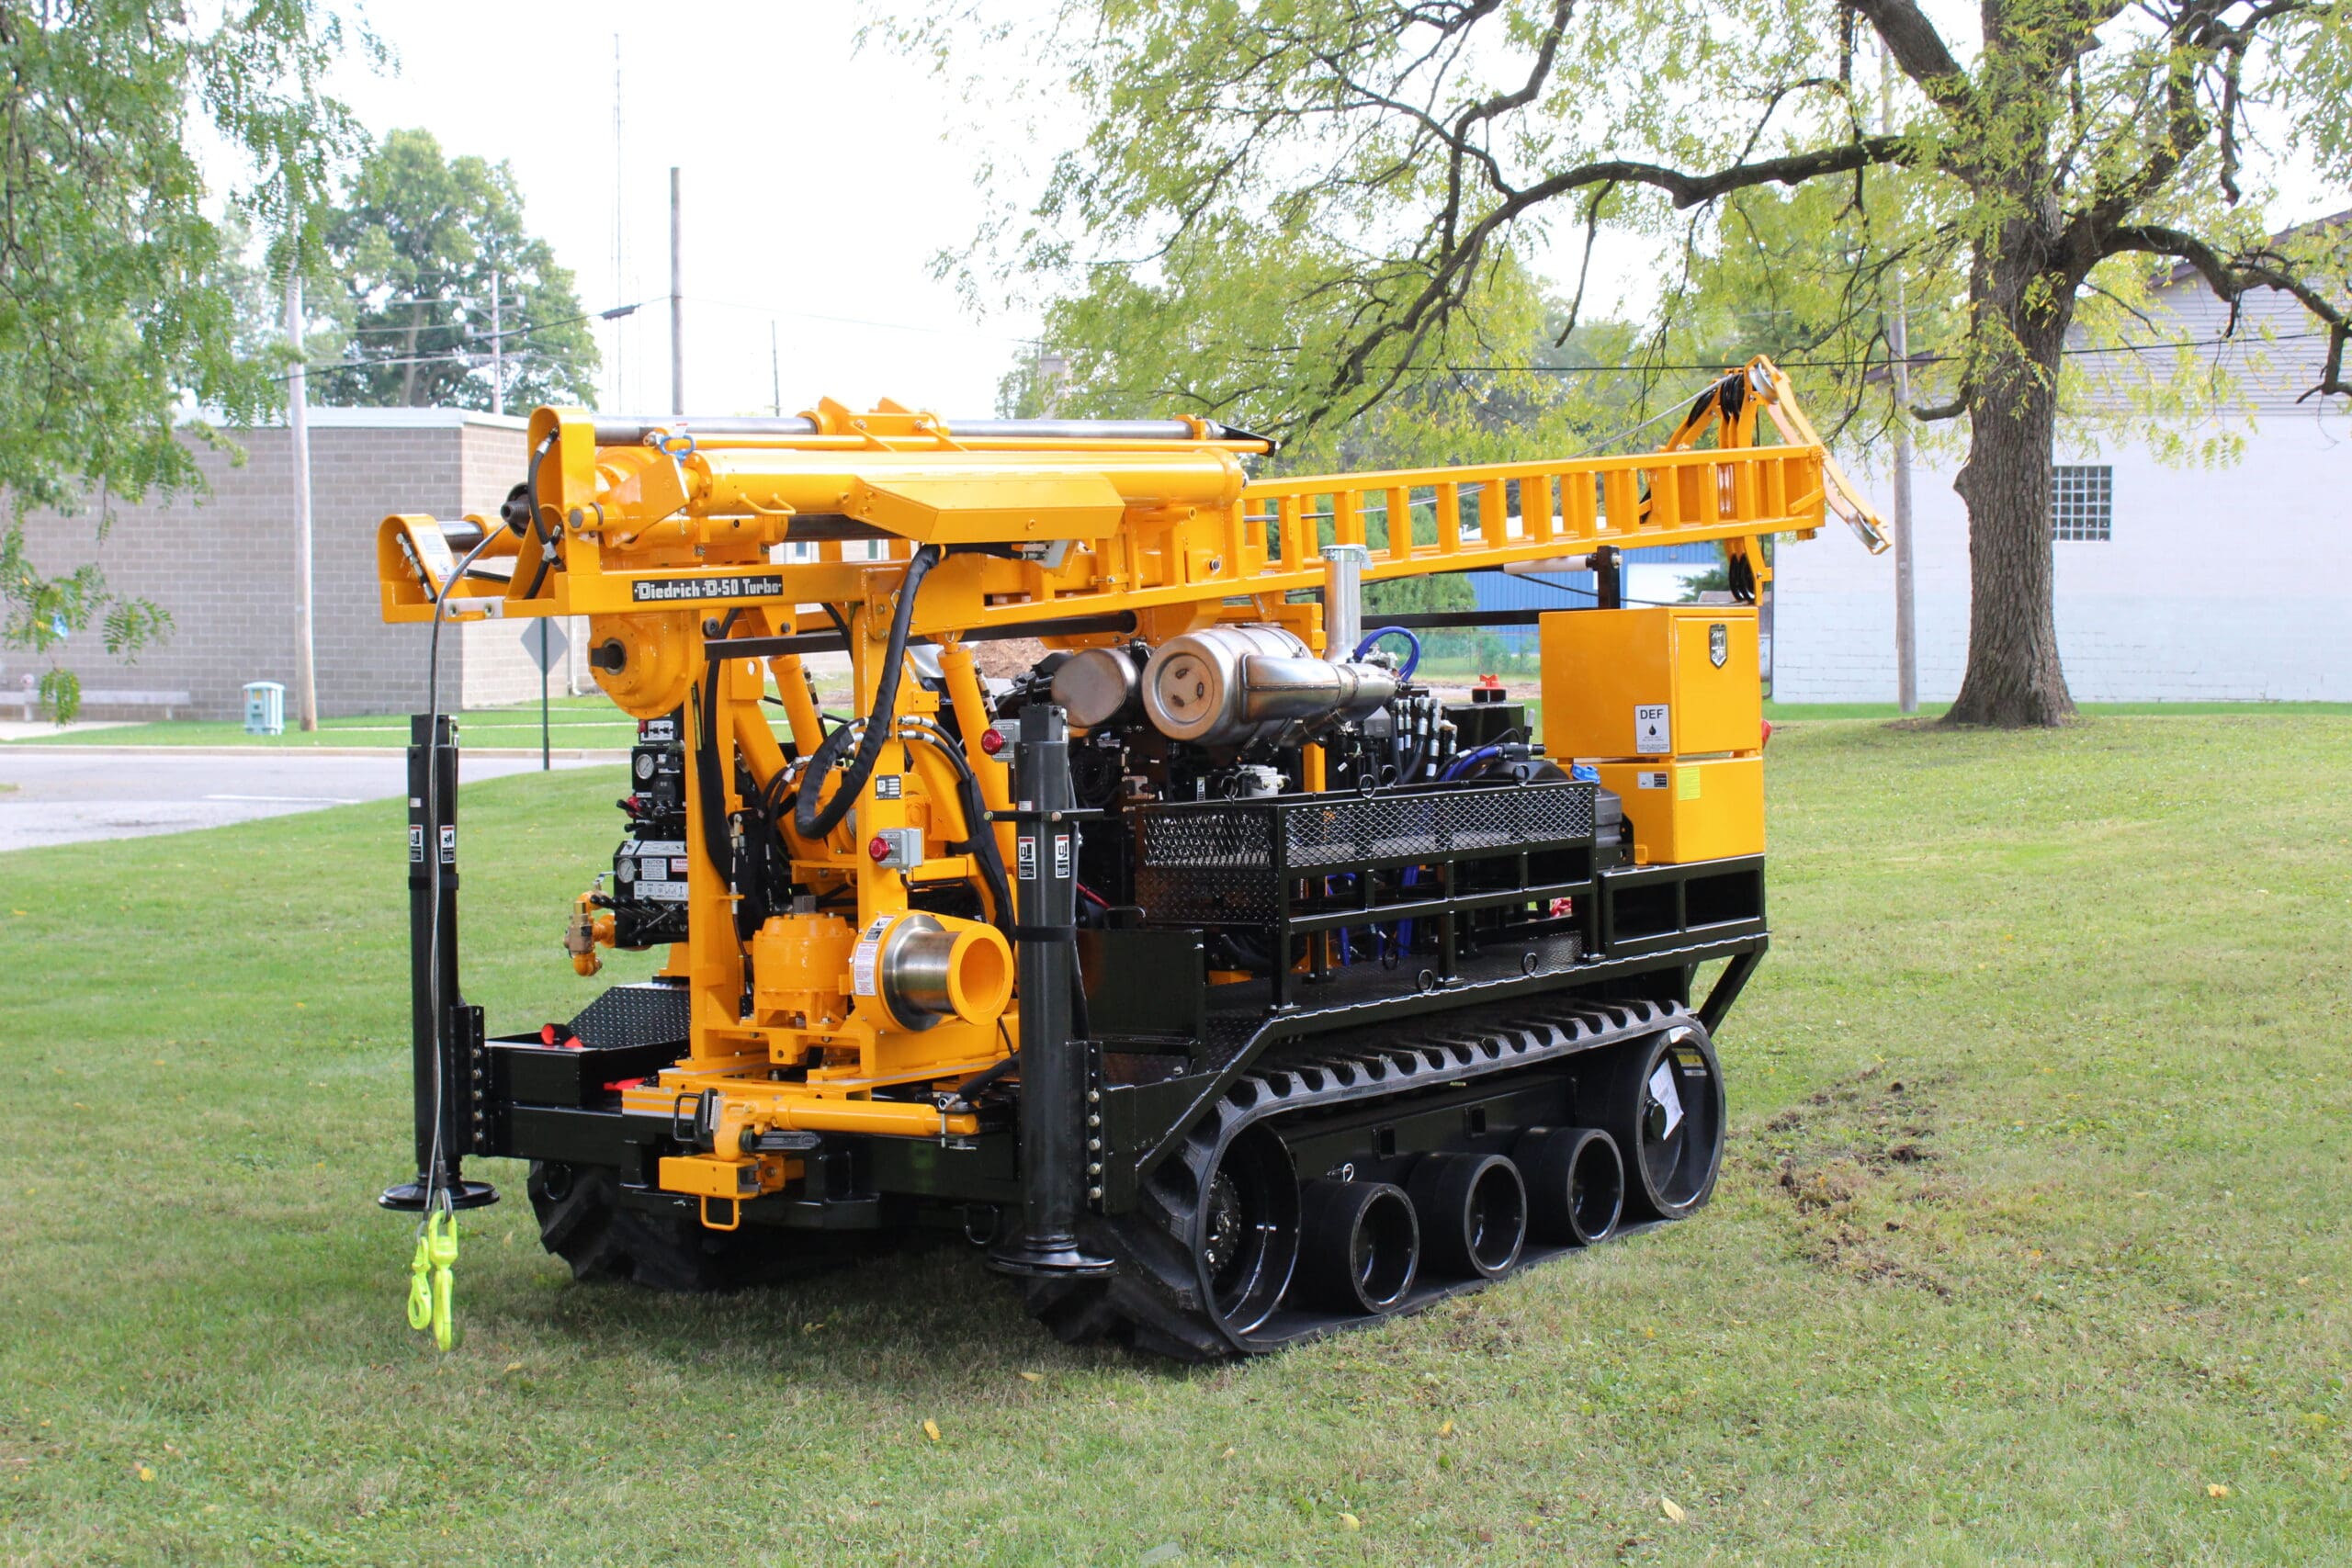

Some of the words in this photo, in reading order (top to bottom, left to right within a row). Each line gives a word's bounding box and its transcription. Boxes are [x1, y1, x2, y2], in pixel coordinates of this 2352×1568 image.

[637, 581, 700, 600] Diedrich
[742, 578, 779, 595] Turbo
[1640, 709, 1664, 720] DEF
